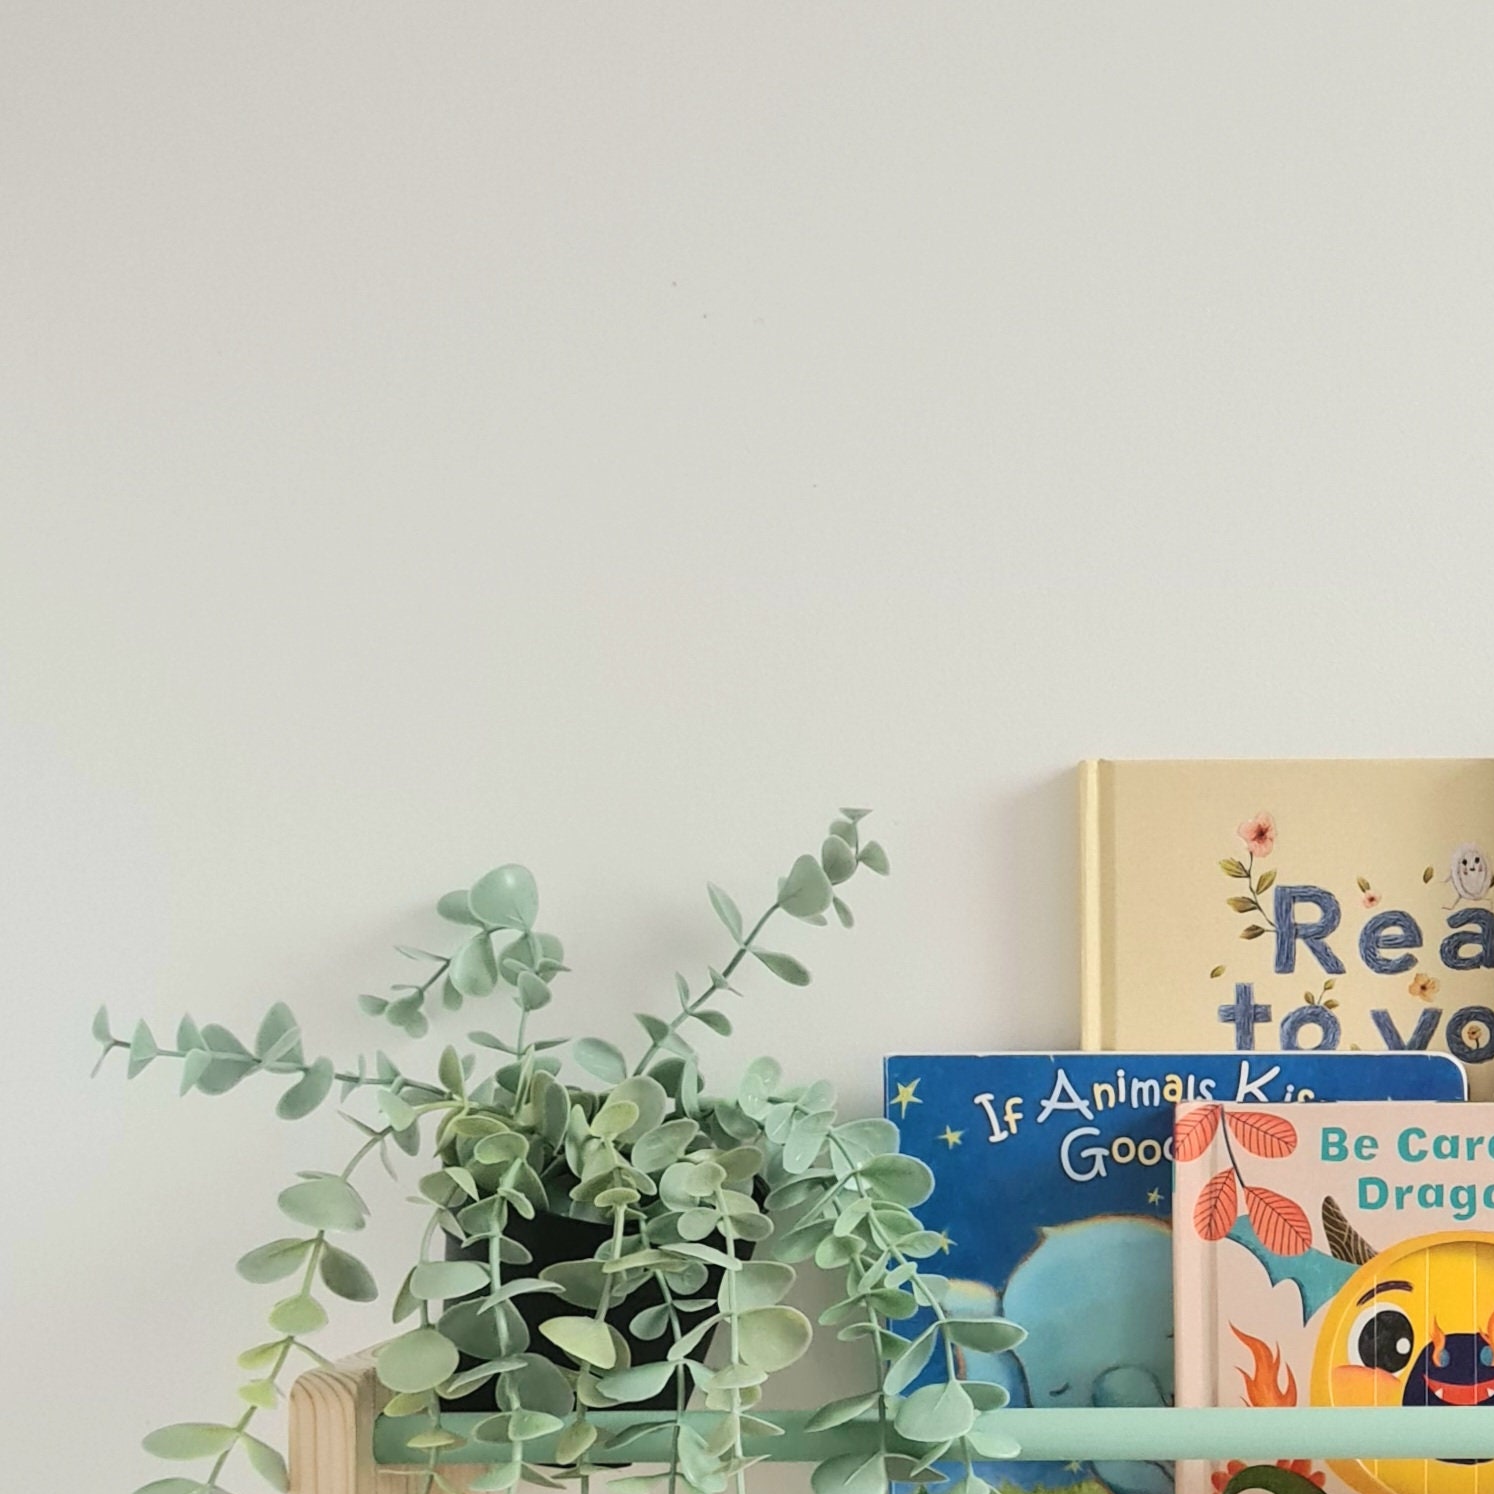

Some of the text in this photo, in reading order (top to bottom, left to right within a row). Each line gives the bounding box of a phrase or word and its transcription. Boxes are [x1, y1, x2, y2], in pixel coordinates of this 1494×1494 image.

[1217, 983, 1341, 1051] to
[973, 1092, 1024, 1143] If
[1036, 1067, 1216, 1124] Animals
[1320, 1126, 1379, 1163] Be
